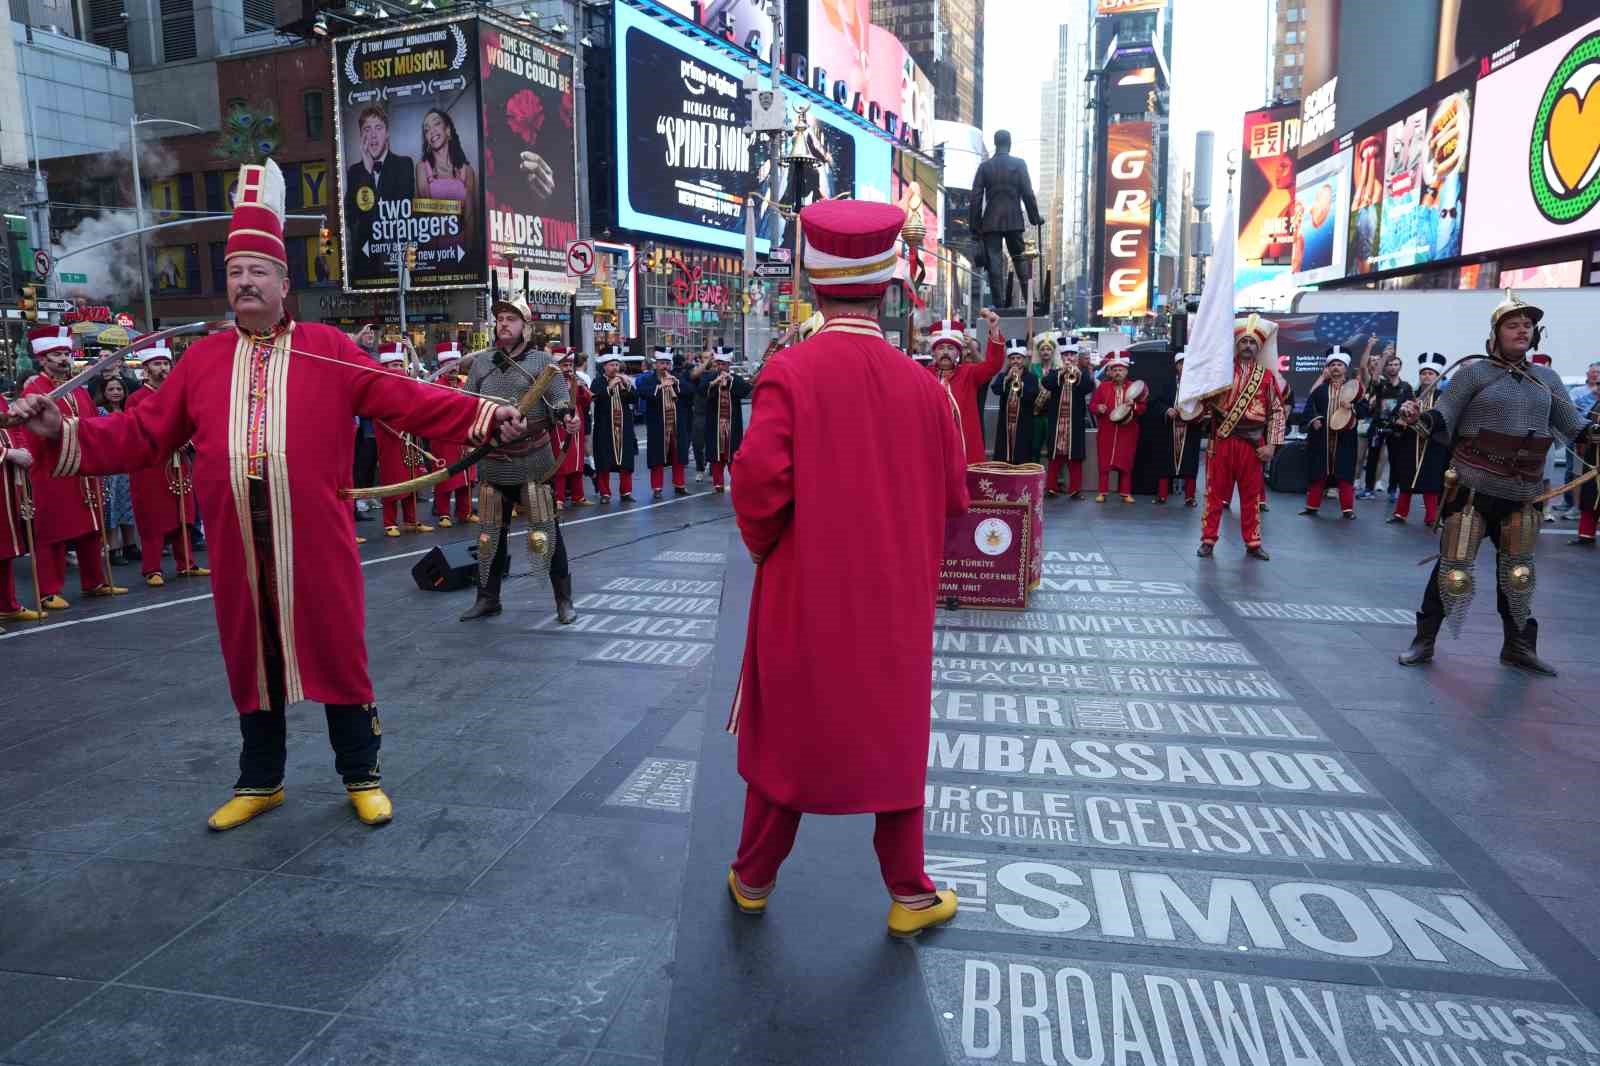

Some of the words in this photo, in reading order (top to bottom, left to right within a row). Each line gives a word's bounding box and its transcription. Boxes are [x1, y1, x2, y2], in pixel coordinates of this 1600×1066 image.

[499, 33, 518, 54] COME
[519, 41, 531, 60] SEE
[363, 58, 392, 80] BEST
[394, 49, 448, 75] MUSICAL
[486, 44, 524, 76] WORLD
[525, 61, 557, 89] COULD
[558, 74, 571, 95] BE
[681, 60, 706, 84] prime
[707, 72, 737, 98] original
[683, 100, 711, 117] NICOLAS
[713, 105, 729, 121] CAGE
[792, 53, 920, 151] BROADWAY
[378, 196, 411, 219] two
[372, 215, 459, 243] strangers
[1109, 150, 1149, 298] GREE
[370, 241, 391, 254] carry
[418, 249, 435, 260] new
[436, 246, 456, 262] york
[528, 289, 572, 306] LUGGAGE
[600, 577, 719, 593] BELASCO
[962, 584, 981, 592] UNIT
[979, 572, 1017, 580] DEFENSE
[1037, 578, 1186, 594] MES
[572, 593, 719, 614] LYCEUM
[1056, 614, 1229, 637] IMPERIAL
[596, 640, 715, 666] CORT
[932, 631, 1098, 657] NTANNE
[1104, 638, 1243, 653] BROOKS
[932, 658, 1098, 675] ARRYMORE
[1111, 649, 1257, 665] ATKINSON
[931, 670, 1104, 689] GACRE
[1108, 665, 1232, 680] SAMUEL
[1110, 676, 1281, 698] FRIEDMAN
[1125, 700, 1320, 740] O'NEILL
[928, 731, 1368, 794] MBASSADOR
[924, 785, 1075, 818] IRCLE
[928, 810, 972, 834] THE
[980, 814, 1079, 842] SQUARE
[1085, 795, 1434, 867] GERSHWIN
[994, 861, 1530, 971] SIMON
[960, 959, 1357, 1066] BROADWAY
[1366, 994, 1600, 1055] AUGUST
